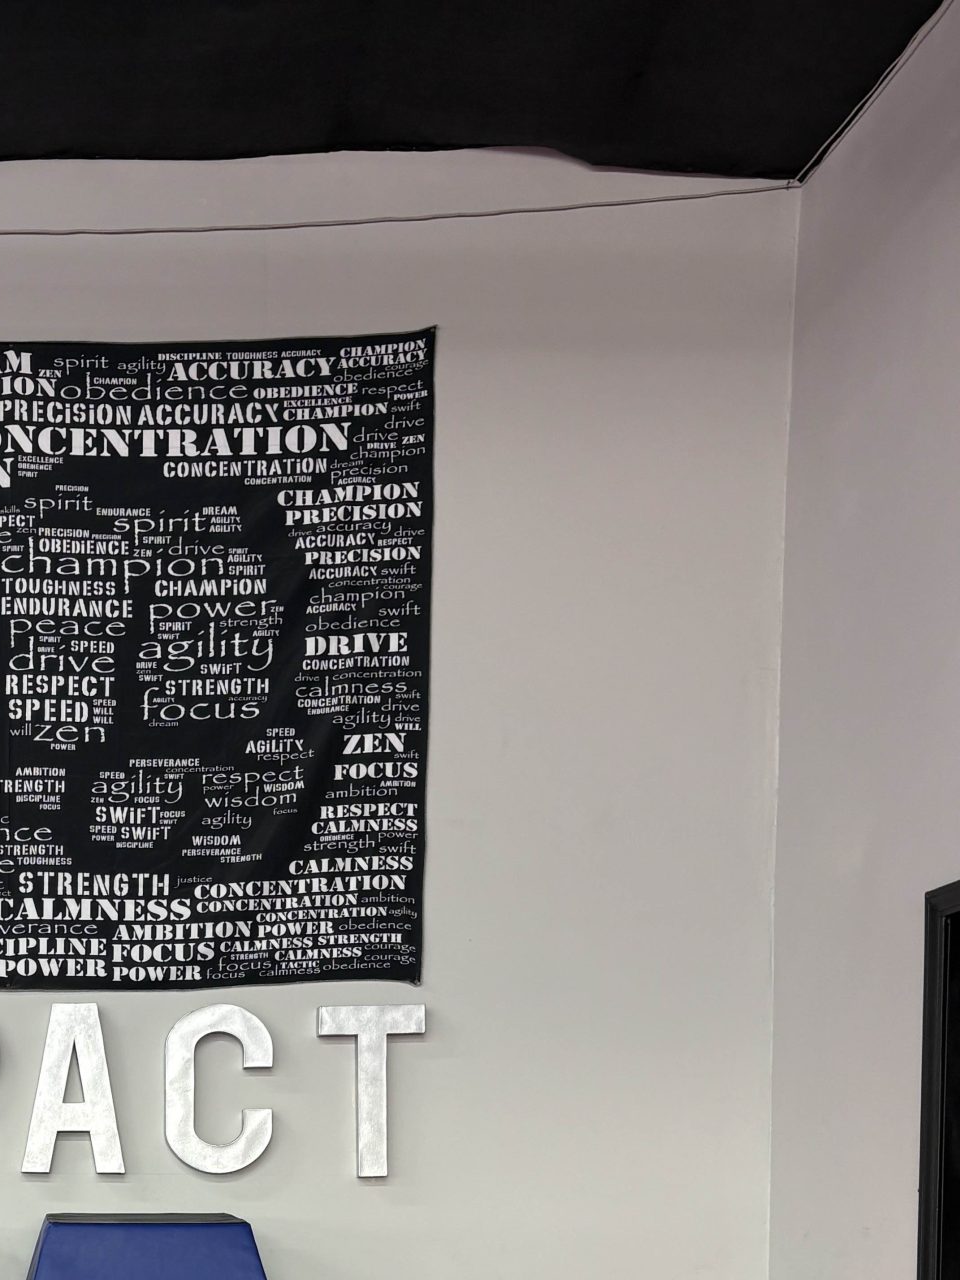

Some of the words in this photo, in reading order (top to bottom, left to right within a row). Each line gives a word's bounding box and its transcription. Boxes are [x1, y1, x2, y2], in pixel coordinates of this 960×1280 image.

[117, 356, 166, 375] agility
[226, 350, 278, 360] TOUGHNESS
[385, 359, 429, 372] courage
[167, 357, 337, 381] ACCURACY
[60, 372, 248, 401] obedience
[138, 402, 279, 426] ACCURACY
[282, 402, 389, 421] CHAMPION
[276, 481, 420, 507] CHAMPION
[285, 501, 423, 527] PRECISION
[113, 509, 206, 546] spirit
[0, 535, 224, 596] champion
[304, 546, 422, 566] PRECISION
[0, 577, 116, 597] TOUGHNESS
[0, 596, 133, 620] ENDURANCE
[149, 599, 276, 636] power
[10, 617, 126, 649] peace
[219, 613, 283, 630] strength
[305, 614, 401, 632] obedience
[9, 635, 116, 673] drive
[70, 640, 115, 655] SPEED
[138, 621, 275, 673] agility
[304, 631, 408, 658] DRIVE
[5, 673, 116, 698] RESPECT
[165, 677, 270, 698] STRENGTH
[295, 676, 408, 699] calmness
[141, 686, 260, 721] focus
[129, 757, 200, 771] PERSEVERANCE
[334, 762, 418, 781] FOCUS
[91, 769, 185, 804] agility
[202, 765, 305, 794] respect
[204, 785, 298, 809] wisdom
[181, 846, 243, 858] PERSEVERANCE
[379, 840, 416, 854] swift
[289, 855, 414, 877] CALMNESS
[18, 871, 171, 898] STRENGTH
[194, 873, 408, 901] CONCENTRATION
[196, 892, 358, 914] CONCENTRATION
[256, 906, 388, 923] CONCENTRATION
[112, 920, 252, 942] AMBITION
[364, 954, 416, 964] courage
[112, 965, 201, 982] POWER
